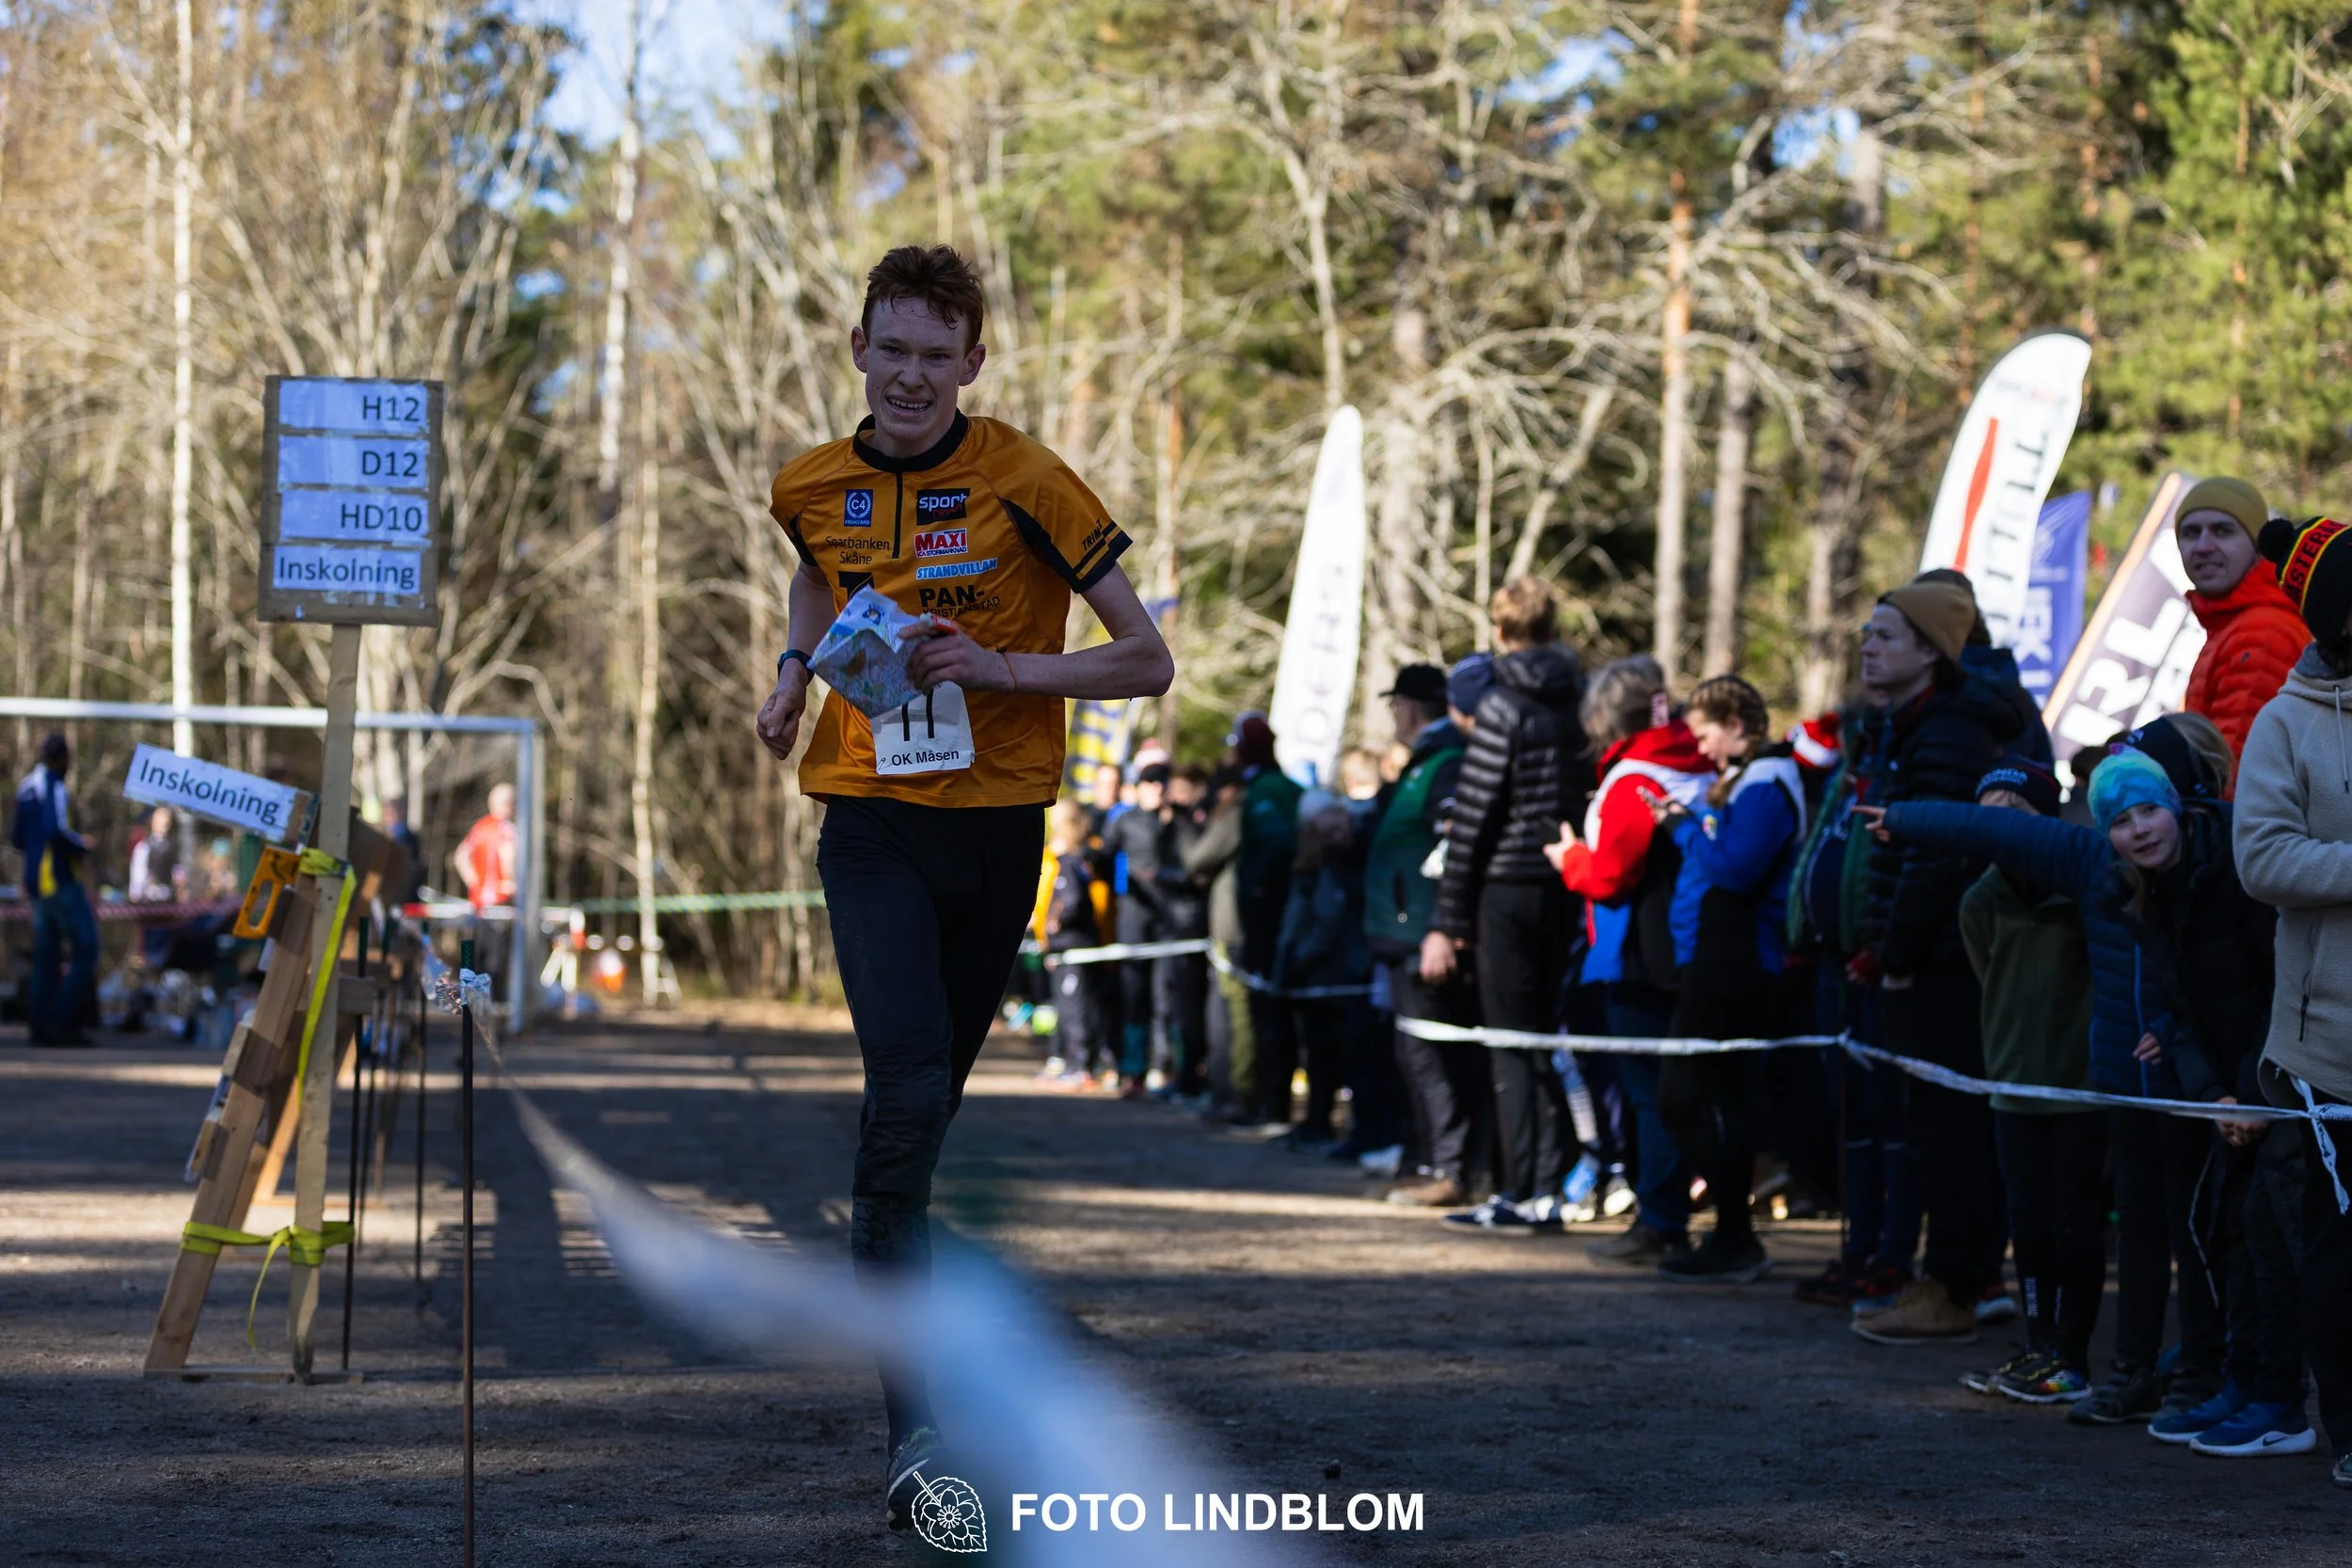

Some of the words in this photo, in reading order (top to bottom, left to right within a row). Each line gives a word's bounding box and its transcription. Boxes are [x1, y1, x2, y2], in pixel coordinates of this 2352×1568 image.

[362, 396, 421, 422] H12
[362, 451, 418, 478] D12
[850, 499, 866, 510] C4
[918, 493, 967, 512] sport
[340, 503, 422, 531] HD10
[825, 536, 890, 550] Sparbanken
[914, 531, 967, 552] MAXI
[839, 551, 872, 564] Skåne
[278, 556, 416, 591] Inskolning
[916, 558, 997, 579] STRANDVILLAN
[918, 584, 985, 608] PAN-
[891, 752, 913, 767] OK
[915, 750, 960, 764] Måsen
[139, 758, 280, 826] Inskolning
